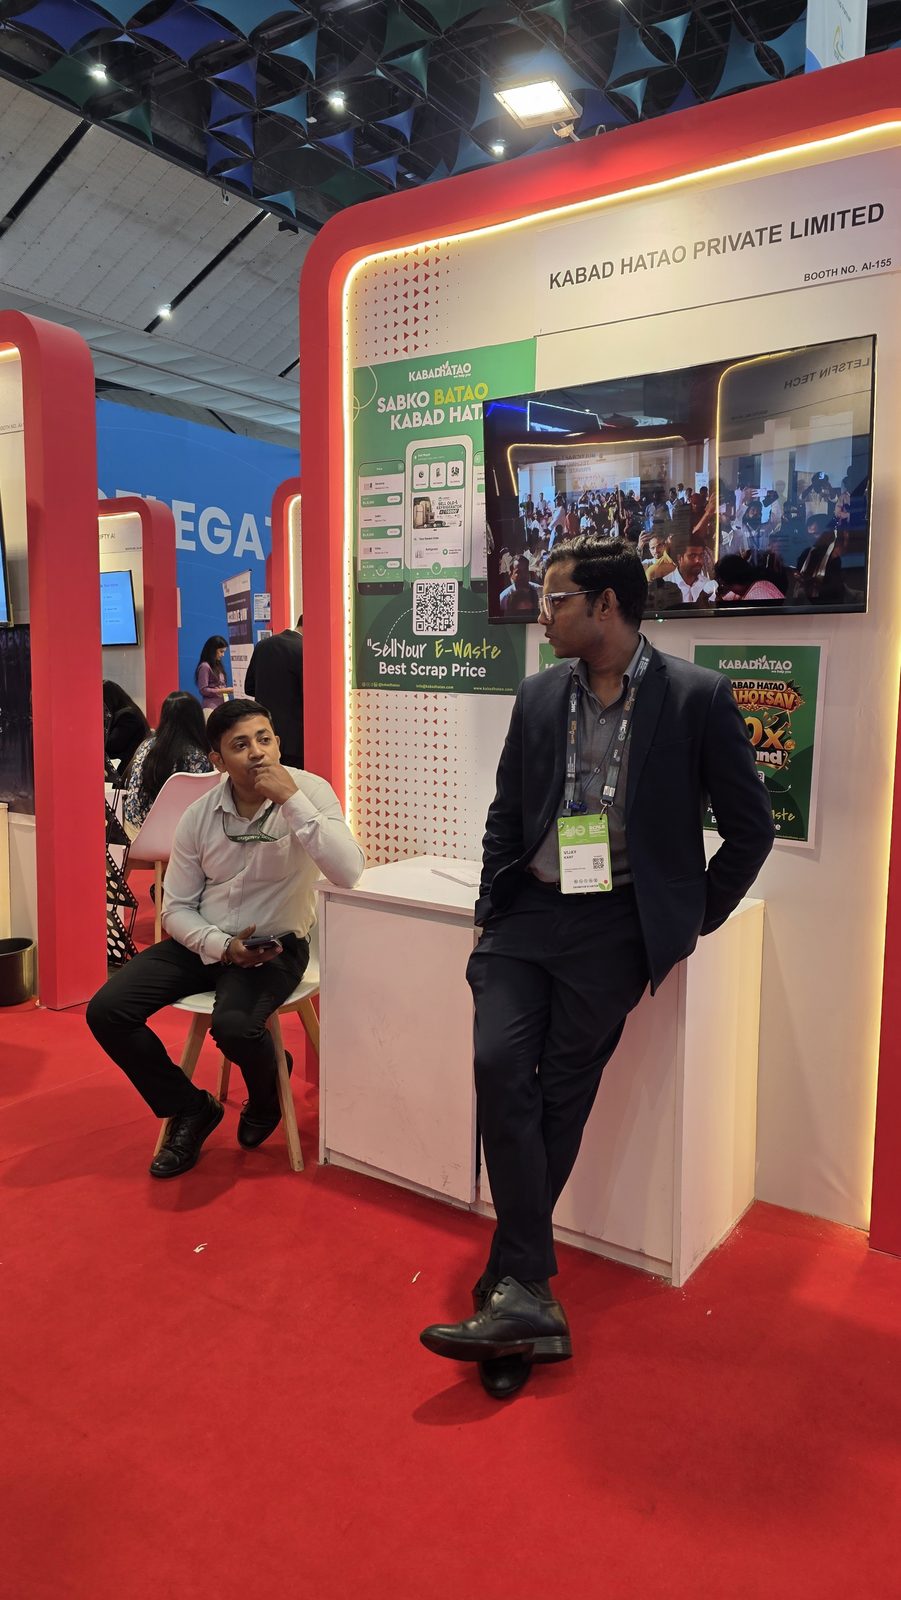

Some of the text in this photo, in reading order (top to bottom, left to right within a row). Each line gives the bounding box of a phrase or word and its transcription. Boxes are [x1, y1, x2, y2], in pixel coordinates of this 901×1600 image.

[549, 202, 885, 290] KABAD HATAO PRIVATE LIMITED
[803, 258, 892, 282] BOOTH NO. AI-155
[377, 383, 489, 413] SABKO BATAO
[390, 403, 484, 430] KABAD HAT
[434, 638, 502, 660] E-Waste
[378, 661, 487, 680] Best Scrap Price
[731, 681, 785, 691] ABAD HATAO
